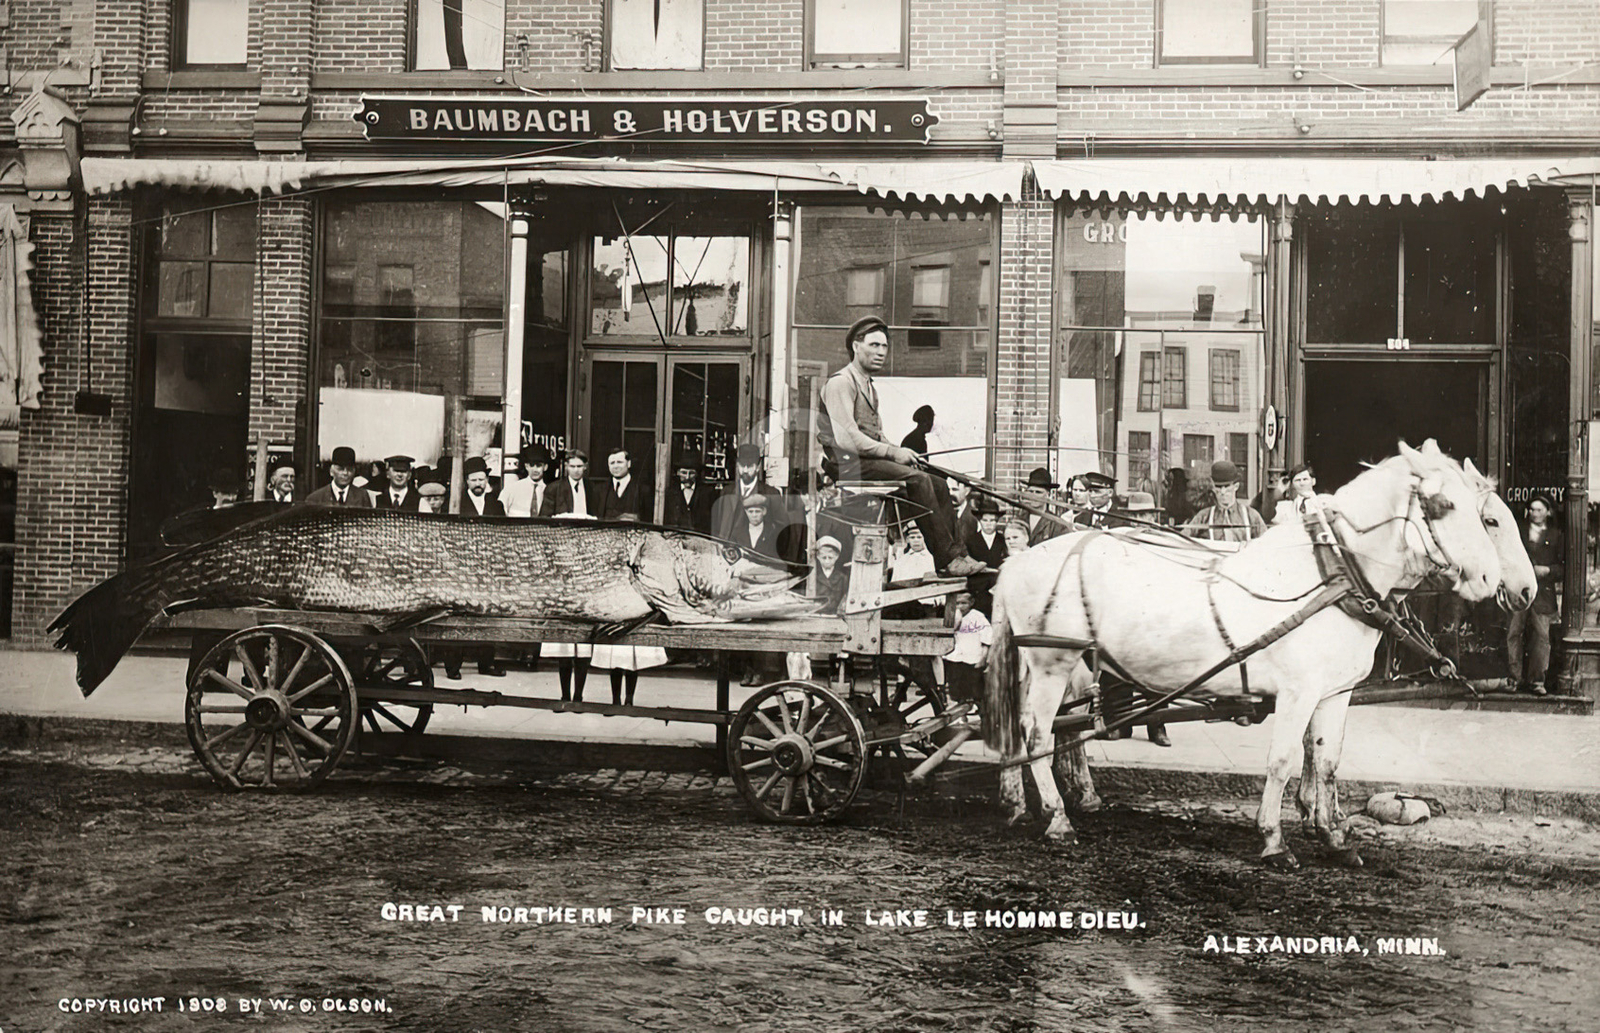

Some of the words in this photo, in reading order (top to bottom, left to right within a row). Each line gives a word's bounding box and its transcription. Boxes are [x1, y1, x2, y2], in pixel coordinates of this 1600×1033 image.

[409, 109, 591, 132] BAUMBACH
[613, 110, 637, 133] &
[663, 108, 893, 133] HOLVERSON.
